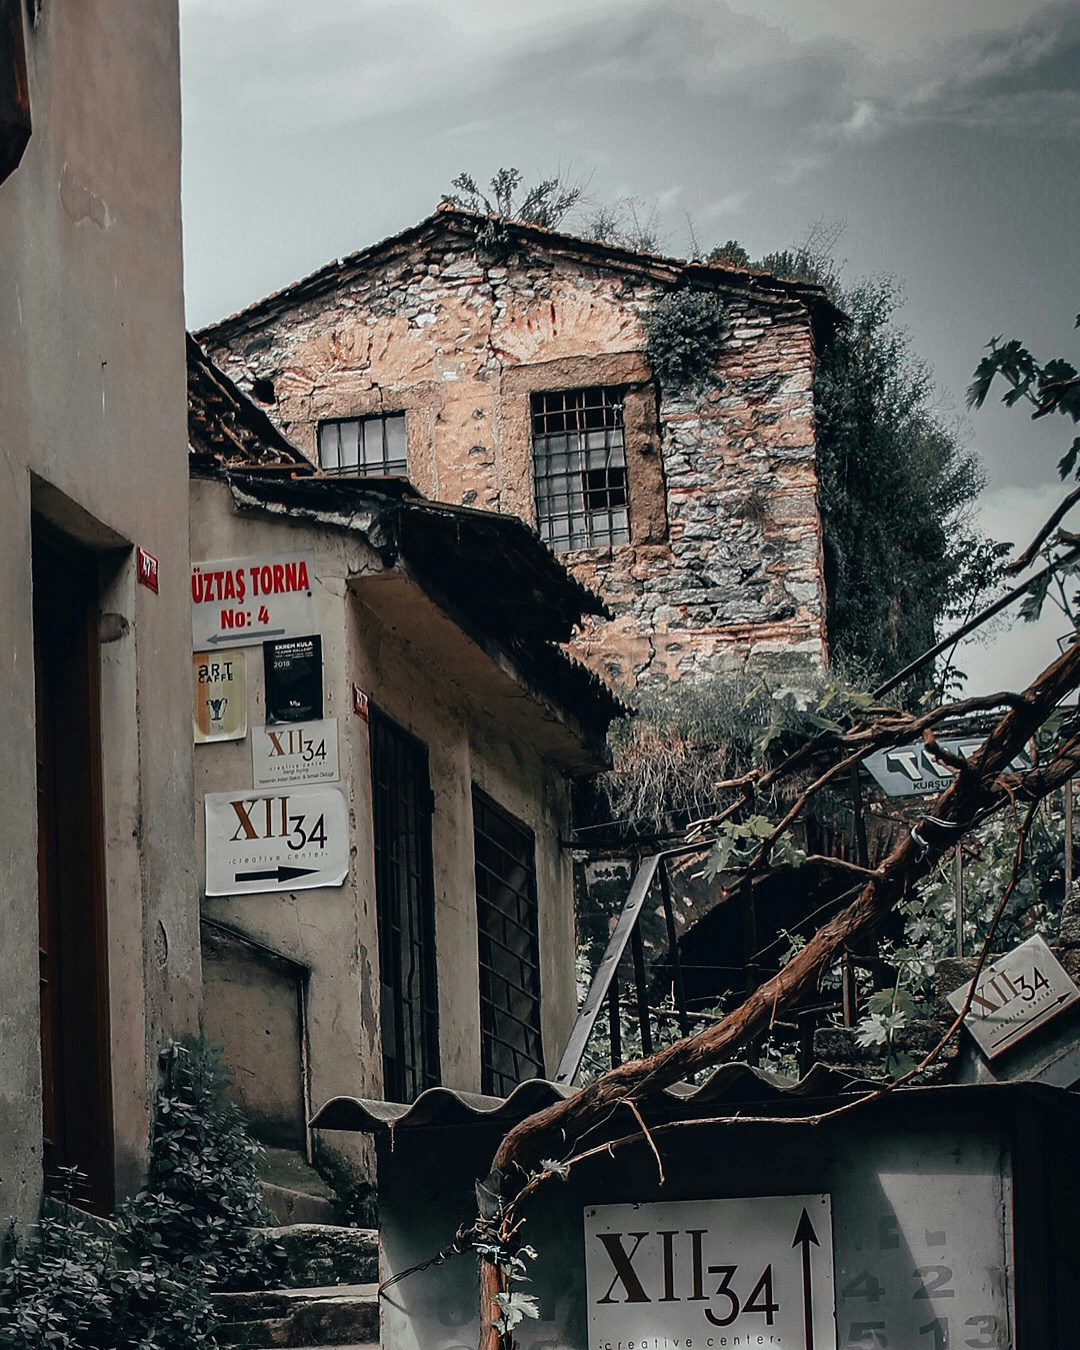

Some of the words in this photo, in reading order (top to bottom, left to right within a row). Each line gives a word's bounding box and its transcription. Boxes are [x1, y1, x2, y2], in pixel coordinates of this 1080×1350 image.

[191, 567, 246, 604] ÜZTAŞ
[250, 561, 310, 596] TORNA
[221, 609, 253, 630] No:
[257, 605, 270, 625] 4
[273, 660, 291, 669] 2018
[198, 673, 233, 684] CAFFE
[232, 852, 282, 866] creative
[287, 849, 326, 862] center
[706, 1333, 777, 1349] center
